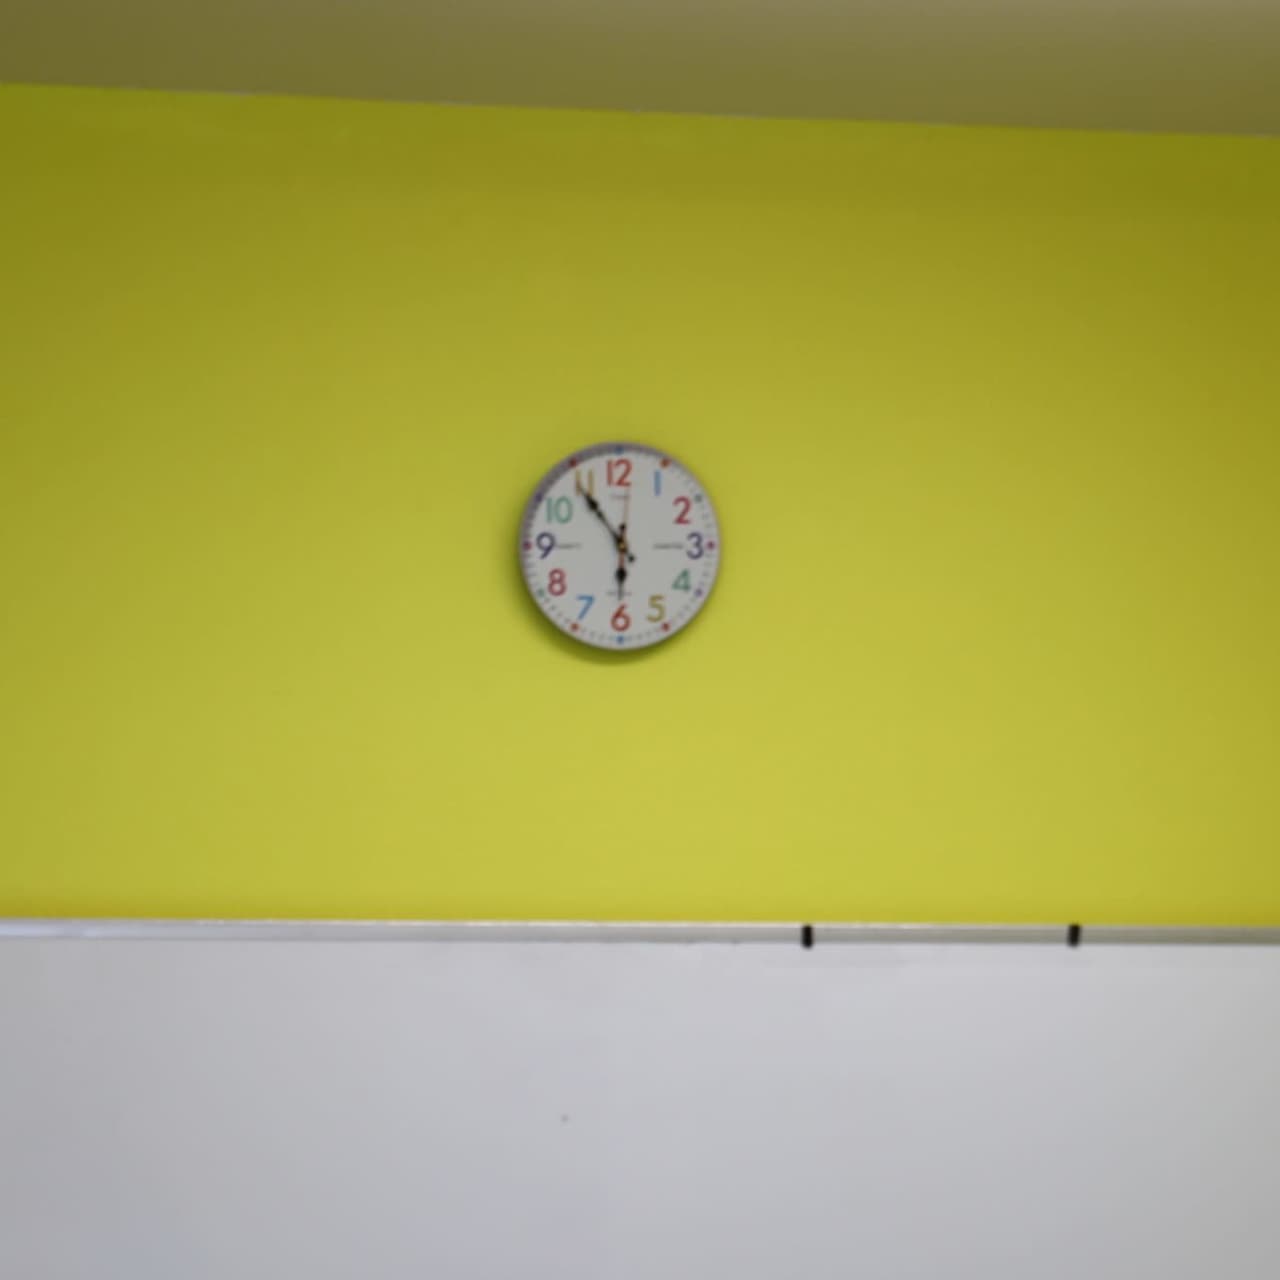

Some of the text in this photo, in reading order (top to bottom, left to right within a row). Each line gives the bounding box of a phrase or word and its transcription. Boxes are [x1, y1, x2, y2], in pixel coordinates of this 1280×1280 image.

[575, 469, 594, 497] 11
[606, 458, 633, 487] 12
[654, 470, 662, 496] 1
[546, 496, 573, 524] 10
[672, 496, 692, 525] 2
[535, 532, 556, 560] 9
[686, 532, 704, 560] 3
[547, 568, 567, 597] 8
[672, 569, 691, 592] 4
[577, 595, 596, 621] 7
[611, 603, 631, 632] 6
[646, 595, 665, 623] 5
